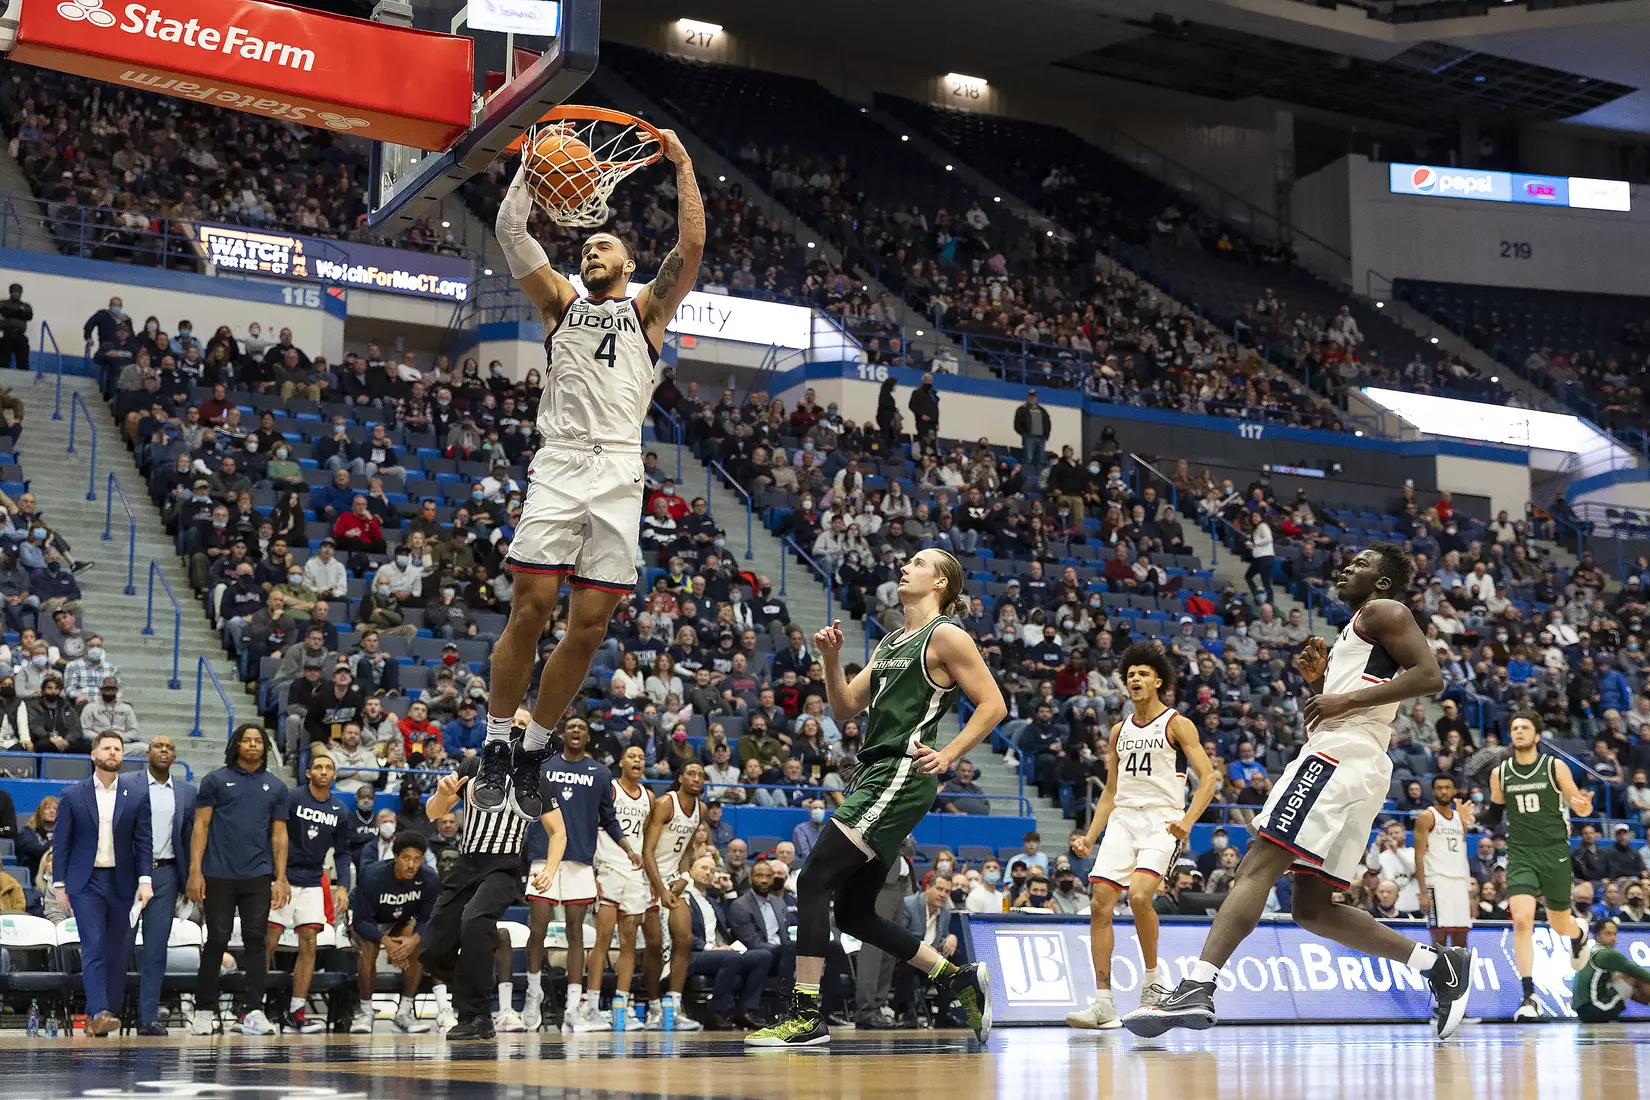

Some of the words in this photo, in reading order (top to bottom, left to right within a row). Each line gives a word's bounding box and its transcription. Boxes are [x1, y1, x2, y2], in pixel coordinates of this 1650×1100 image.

[120, 3, 221, 51] State
[222, 26, 316, 72] Farm
[685, 28, 714, 48] 217
[119, 69, 219, 100] Farm
[952, 81, 980, 100] 218
[216, 90, 316, 120] State
[1439, 174, 1492, 194] pepsi
[208, 236, 290, 264] WATCH
[1500, 240, 1533, 260] 219
[212, 254, 239, 268] FOR
[239, 257, 259, 271] ME
[315, 259, 467, 301] WatchForMeCT.org
[281, 286, 321, 309] 115
[567, 312, 637, 334] UCONN
[672, 301, 733, 333] nity
[594, 332, 617, 368] 4
[857, 362, 890, 381] 116
[1238, 422, 1264, 440] 117
[1117, 738, 1164, 753] UCONN
[1125, 752, 1152, 777] 44
[545, 770, 595, 787] UCONN
[1275, 760, 1325, 834] HUSKIES
[1514, 792, 1541, 814] 10
[621, 818, 641, 839] 24
[668, 822, 697, 835] UCON
[673, 836, 686, 853] 5
[1446, 837, 1459, 853] 12
[379, 890, 422, 906] UCONN
[1299, 943, 1501, 992] BRUNTI
